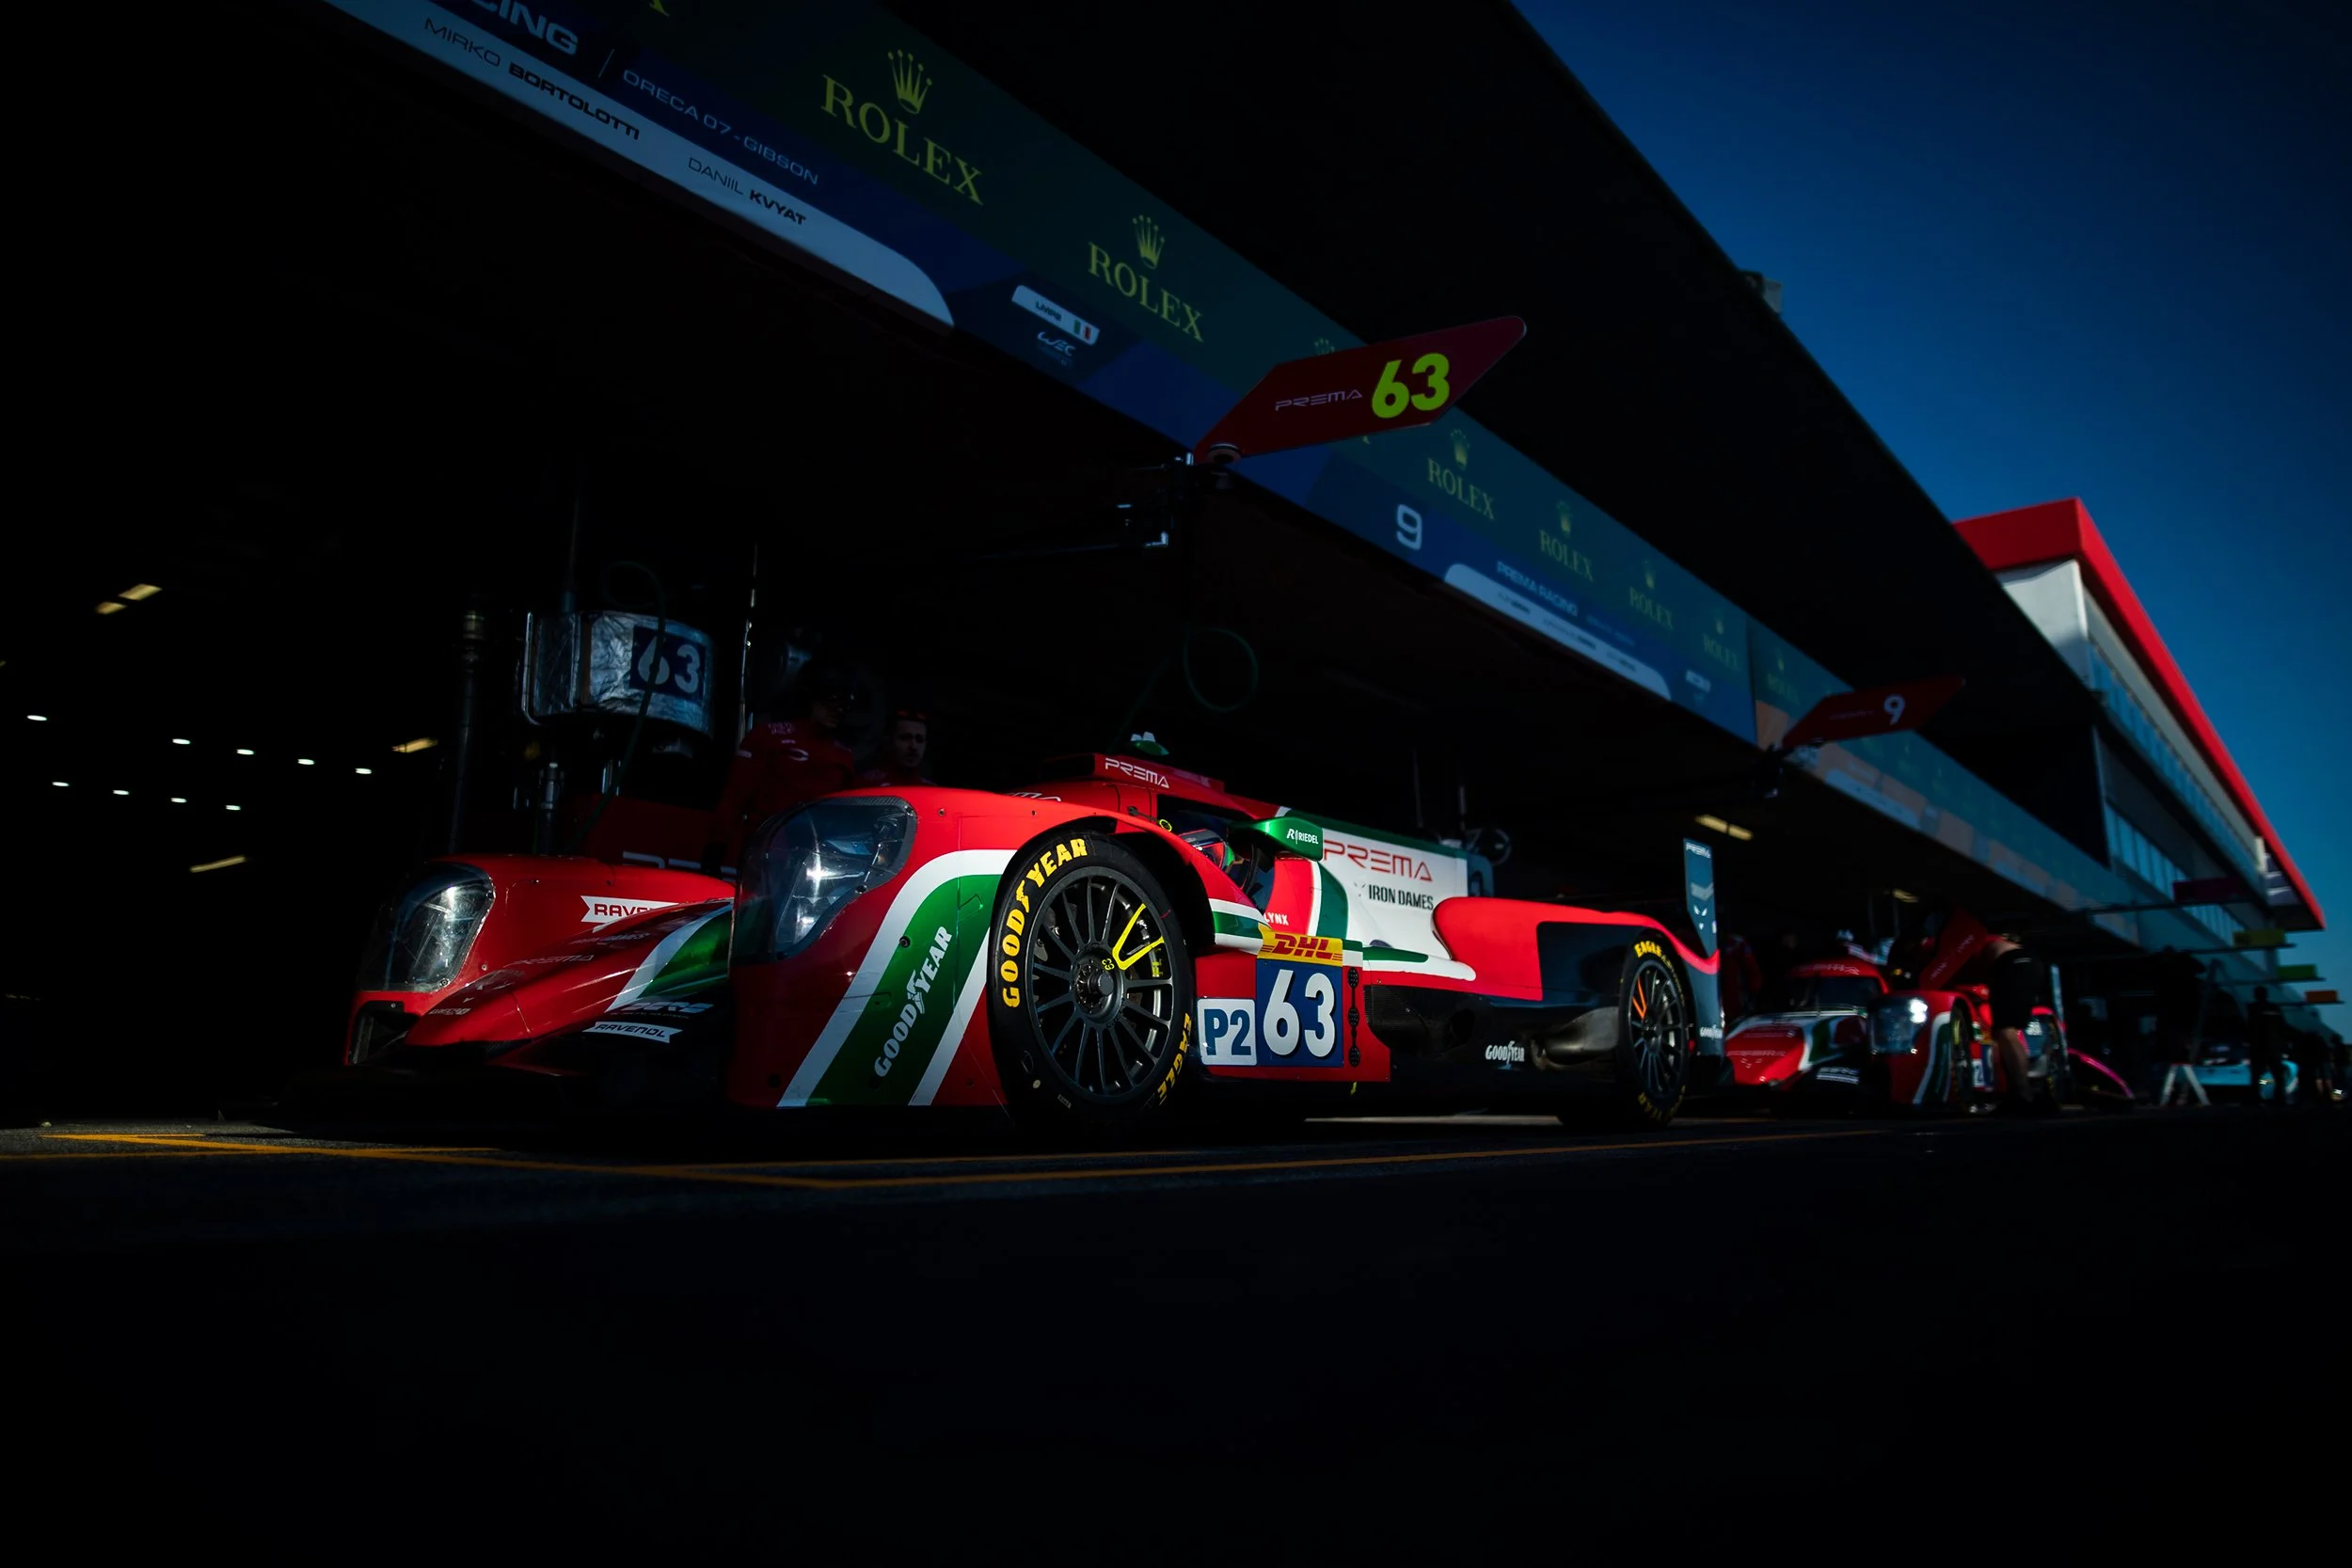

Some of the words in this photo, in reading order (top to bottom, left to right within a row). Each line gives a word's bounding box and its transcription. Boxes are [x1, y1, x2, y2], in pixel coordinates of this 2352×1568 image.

[423, 17, 501, 67] MIRKO
[508, 62, 640, 140] BORTOLOTTI
[622, 67, 700, 122] ORECA
[703, 112, 734, 136] 07
[742, 135, 818, 186] GIBSON
[820, 73, 983, 206] ROLEX
[688, 157, 744, 196] DANIIL
[749, 189, 806, 226] KVYAT
[1088, 241, 1204, 343] ROLEX
[1275, 388, 1363, 412] PREMA
[1371, 352, 1452, 419] 63
[1426, 457, 1495, 520] ROLEX
[1395, 503, 1423, 552] 9
[1538, 529, 1595, 583] ROLEX
[1629, 586, 1674, 631] ROLEX
[636, 634, 700, 694] 63
[1882, 693, 1906, 726] 9
[1104, 757, 1170, 789] PREMA
[1298, 832, 1319, 845] RIEDEL
[1323, 839, 1433, 882] PREMA
[1000, 835, 1089, 1008] GOODYEAR
[1264, 912, 1289, 927] LYNX
[1369, 883, 1395, 906] IRON
[1398, 888, 1434, 911] DAMES
[1271, 933, 1334, 959] DHL
[595, 1023, 665, 1037] RAVENOL
[874, 926, 952, 1078] GOODYEAR
[1202, 1007, 1252, 1056] P2
[1263, 969, 1336, 1058] 63
[1157, 1012, 1192, 1106] EAGLE
[1485, 1039, 1526, 1064] GOODYEAR
